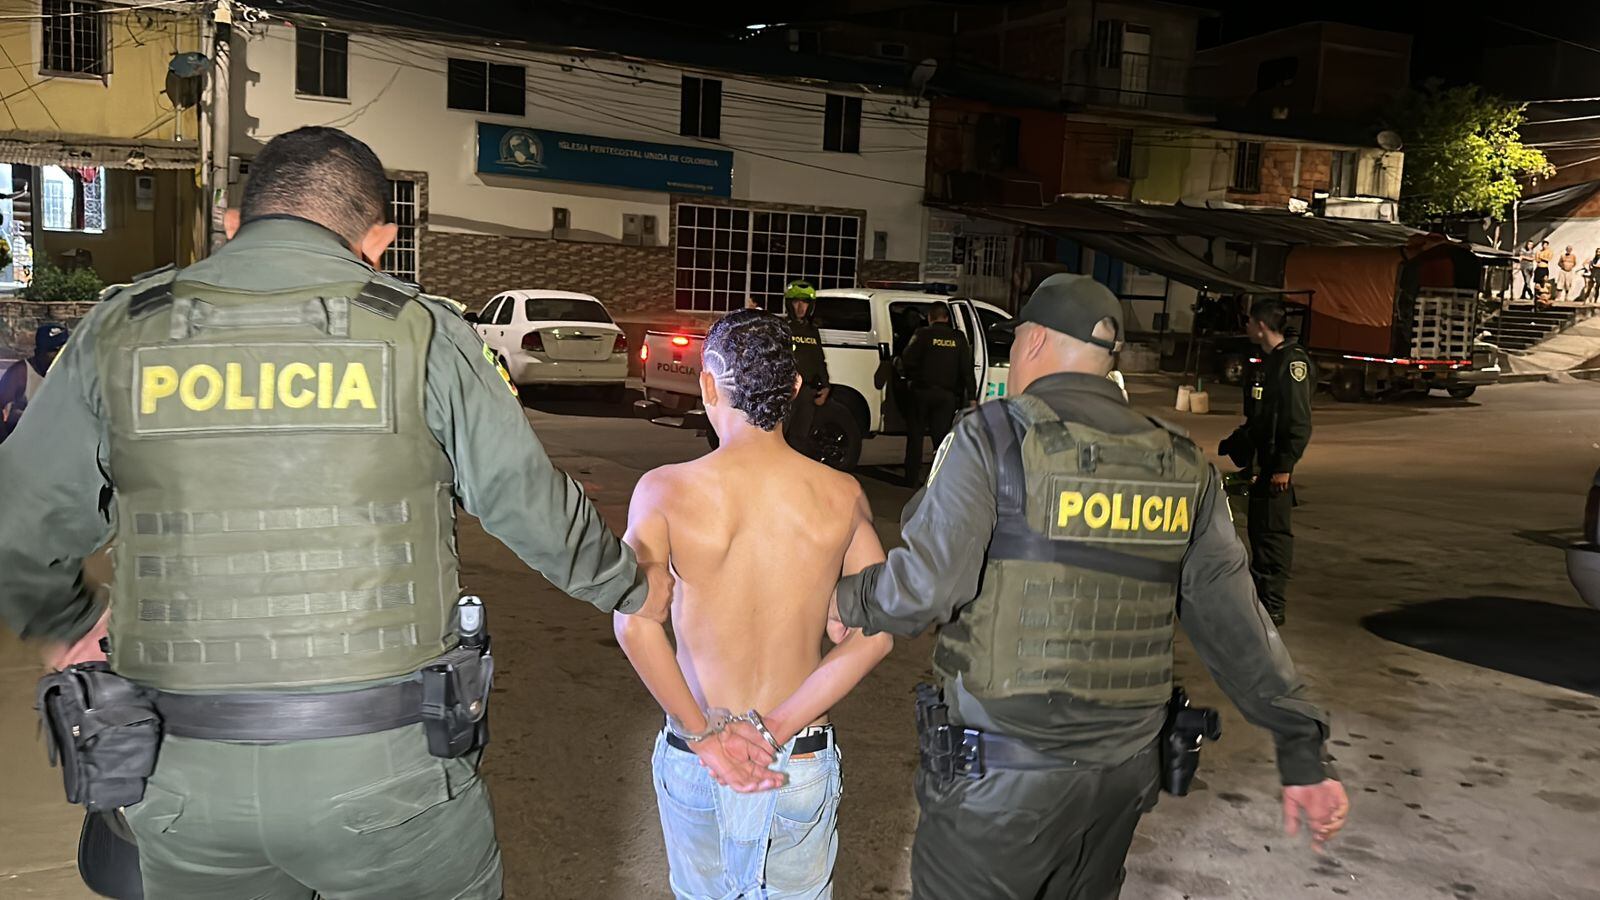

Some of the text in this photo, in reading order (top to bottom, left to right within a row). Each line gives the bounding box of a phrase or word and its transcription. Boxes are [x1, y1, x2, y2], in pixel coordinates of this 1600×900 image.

[558, 141, 718, 167] IGLESIA PENTECOSTAL UNIDA DE COLOMBIA
[792, 336, 817, 345] POLICIA
[932, 338, 956, 347] POLICIA
[657, 362, 697, 376] POLICIA
[140, 361, 378, 414] POLICIA
[1057, 490, 1189, 533] POLICIA
